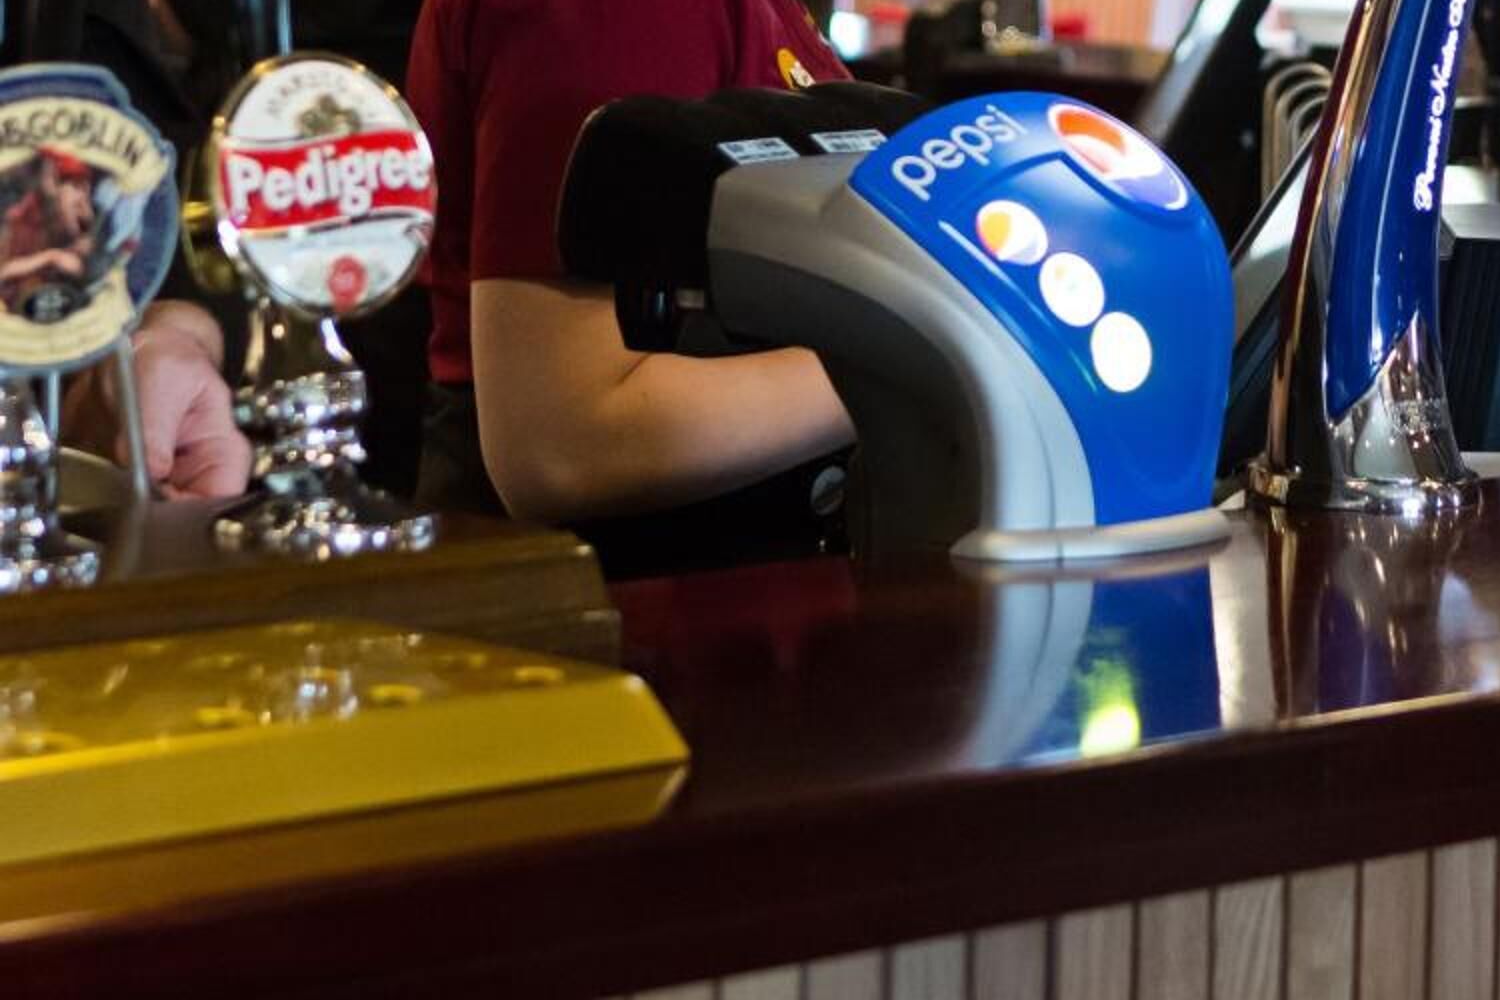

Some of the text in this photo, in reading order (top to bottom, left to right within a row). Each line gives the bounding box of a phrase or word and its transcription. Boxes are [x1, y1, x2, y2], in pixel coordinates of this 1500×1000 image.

[0, 108, 142, 169] BGOBLIN
[892, 104, 1028, 200] pepsi
[226, 144, 431, 223] Pedigree
